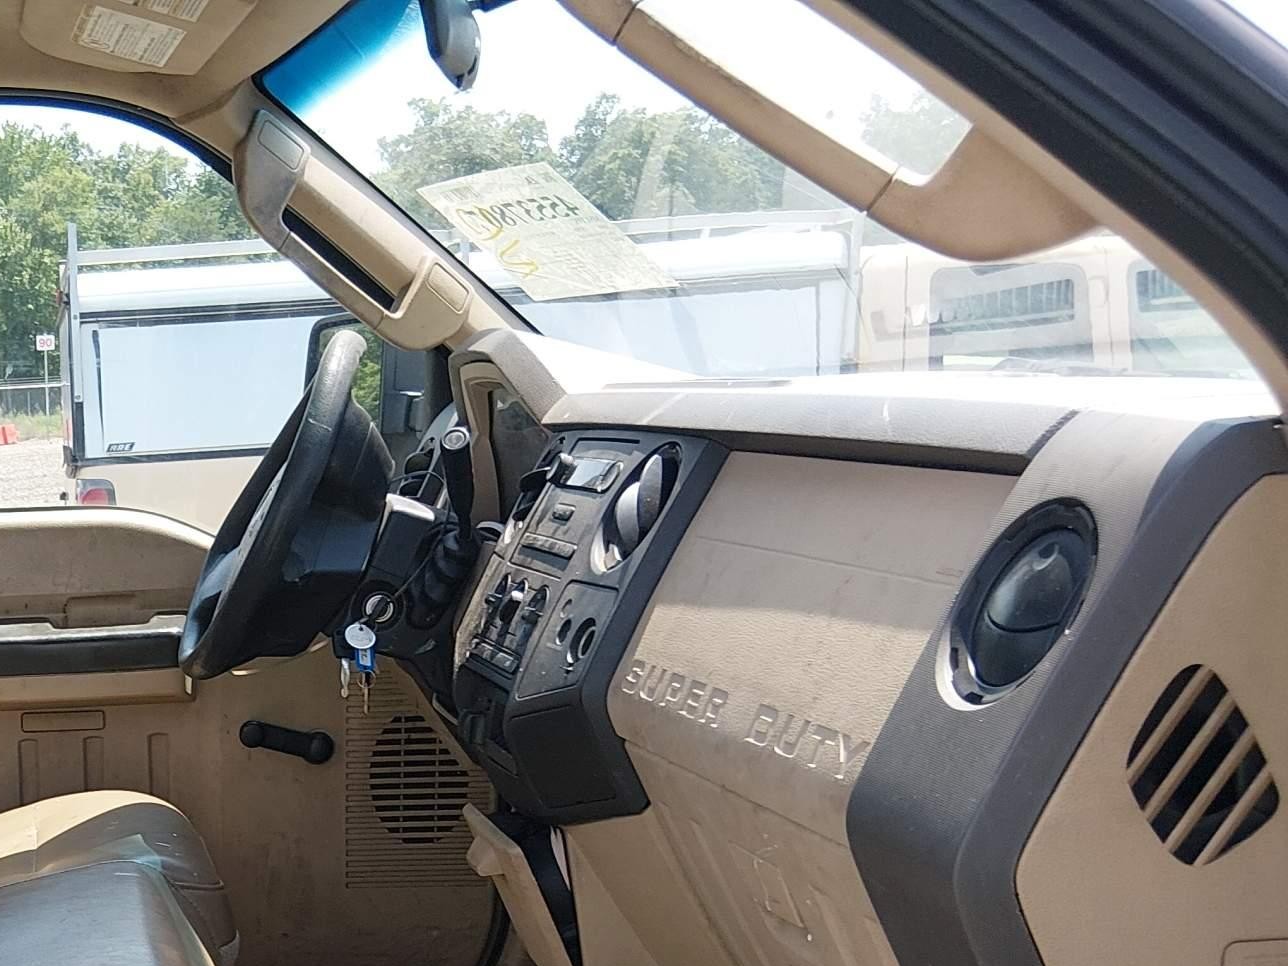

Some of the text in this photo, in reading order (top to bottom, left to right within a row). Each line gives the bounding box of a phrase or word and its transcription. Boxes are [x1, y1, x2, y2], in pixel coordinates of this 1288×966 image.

[38, 338, 53, 348] 90
[621, 658, 871, 780] SUPER DUTY
